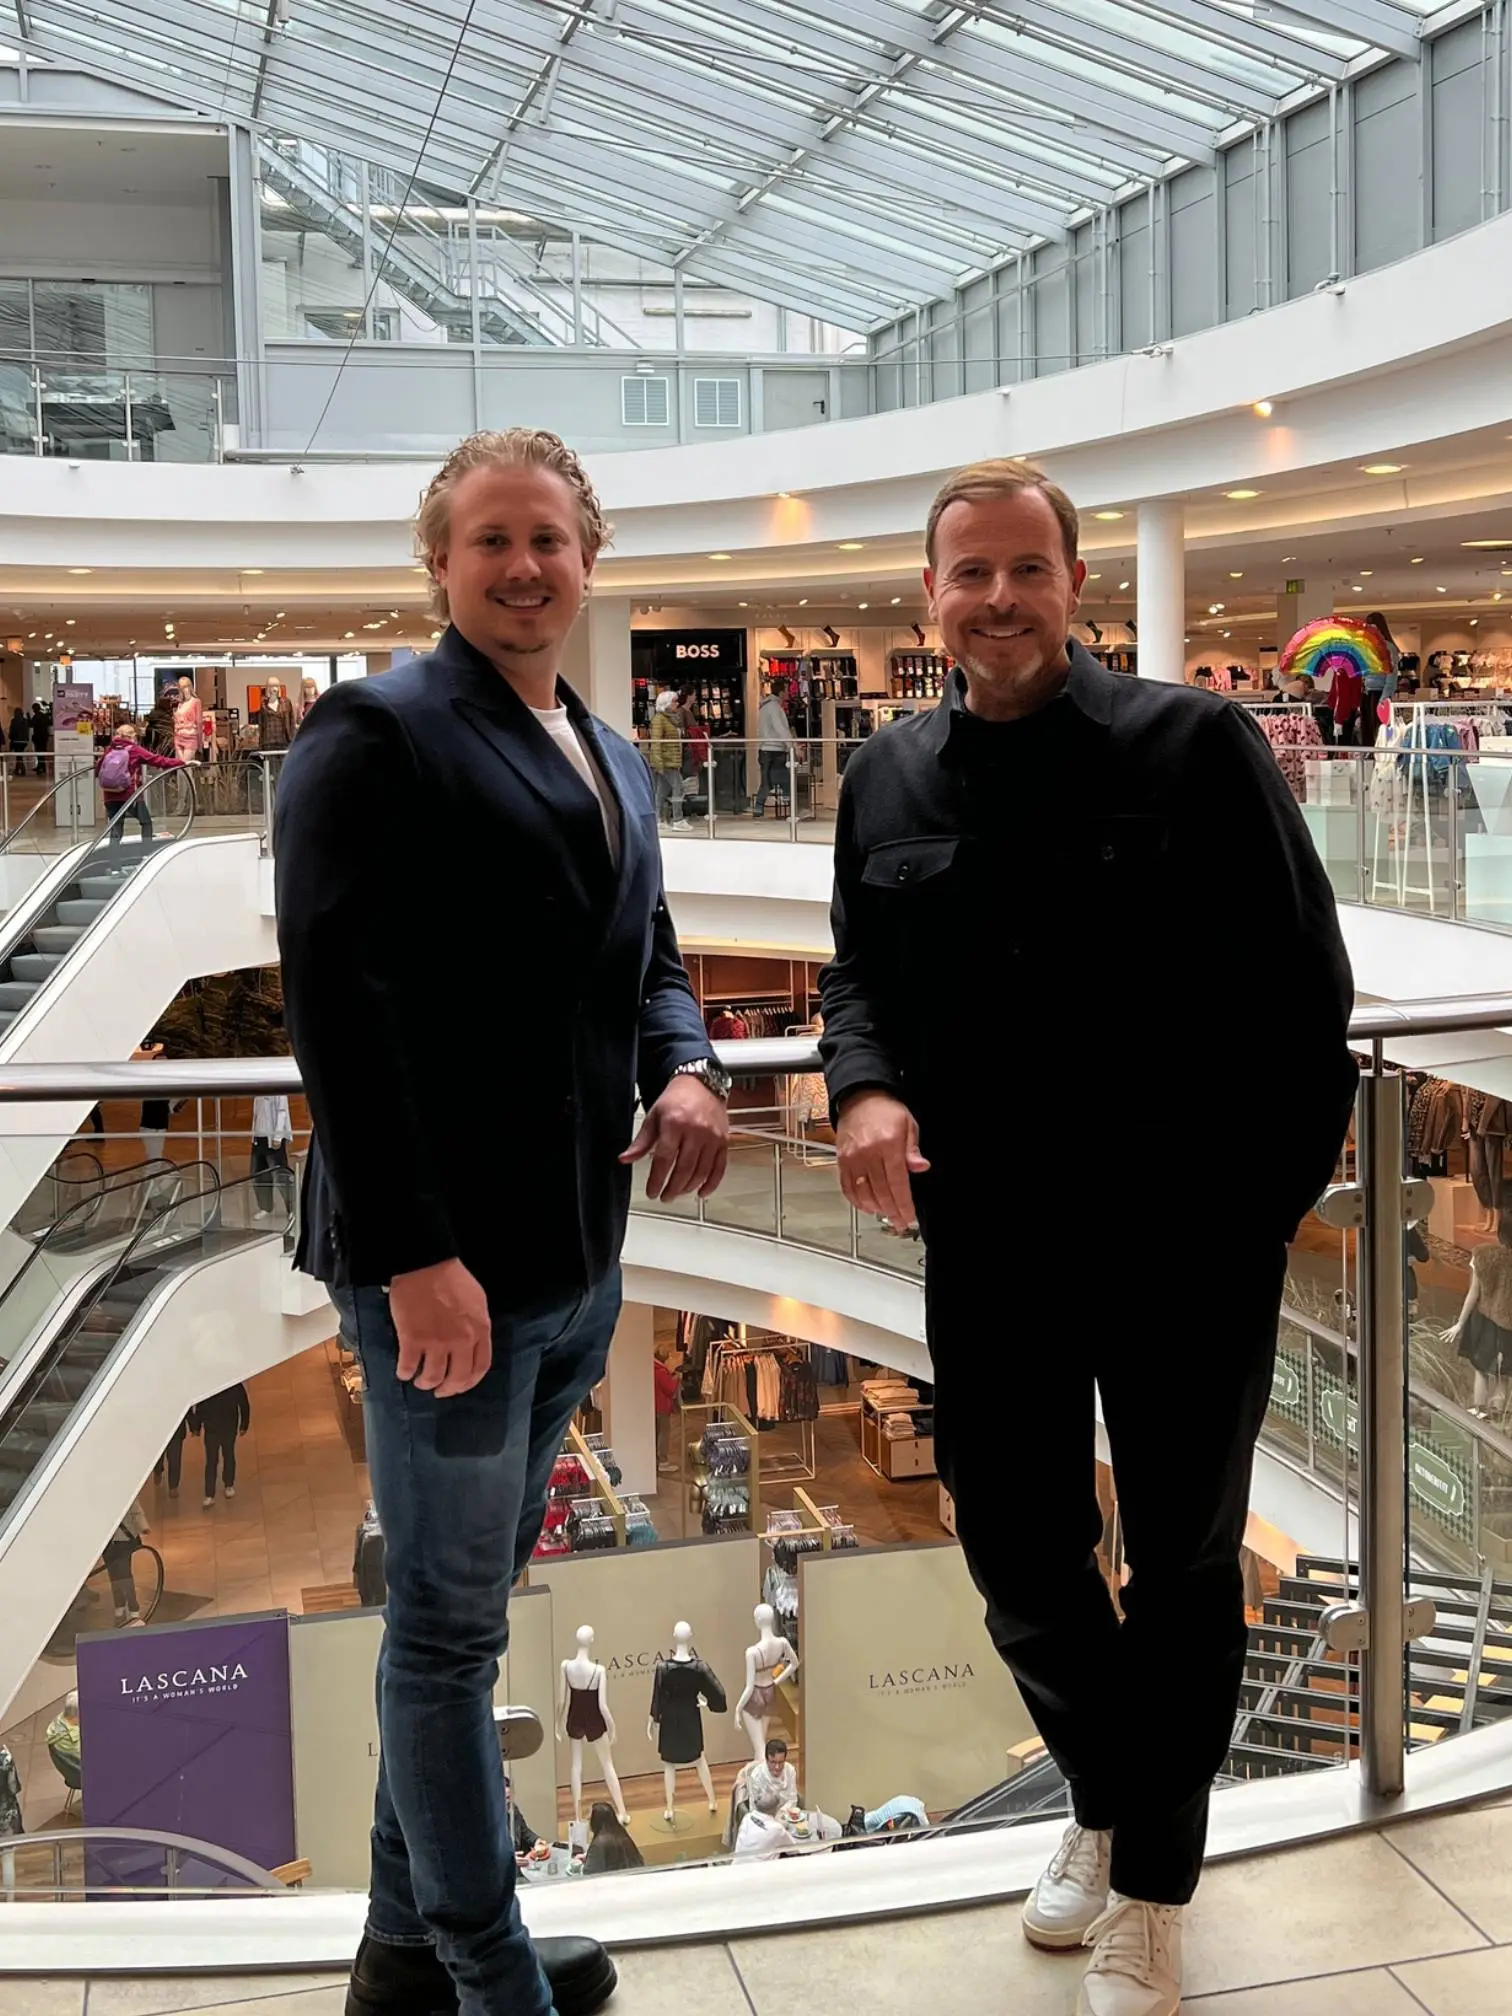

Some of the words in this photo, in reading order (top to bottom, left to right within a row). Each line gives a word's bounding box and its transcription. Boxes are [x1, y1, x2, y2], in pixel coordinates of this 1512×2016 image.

[676, 644, 720, 658] BOSS
[121, 1663, 248, 1694] LASCANA
[869, 1663, 975, 1689] LASCANA
[208, 1683, 238, 1693] WORLD
